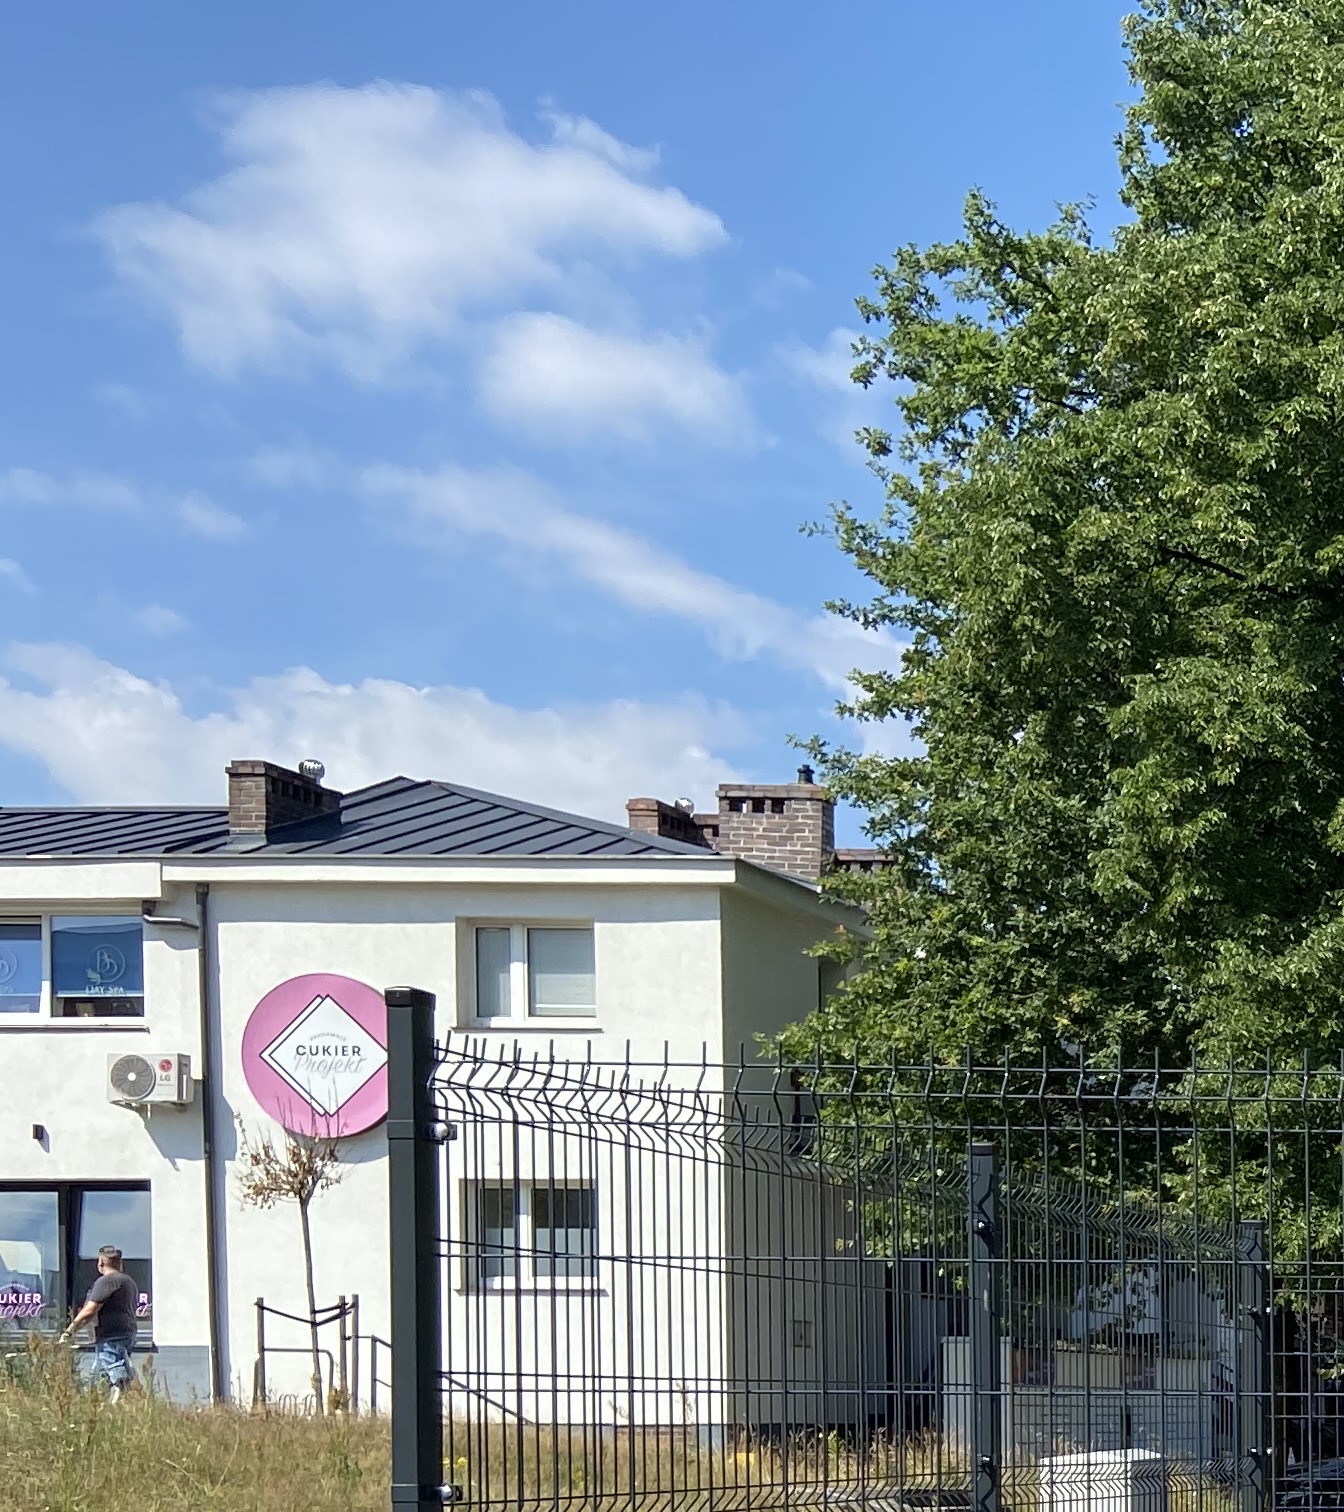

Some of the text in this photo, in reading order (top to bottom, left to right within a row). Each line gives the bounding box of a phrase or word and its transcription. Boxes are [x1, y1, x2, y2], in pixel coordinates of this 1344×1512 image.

[296, 1045, 361, 1056] CUKIER
[294, 1054, 367, 1079] Projekt
[160, 1074, 171, 1082] LG
